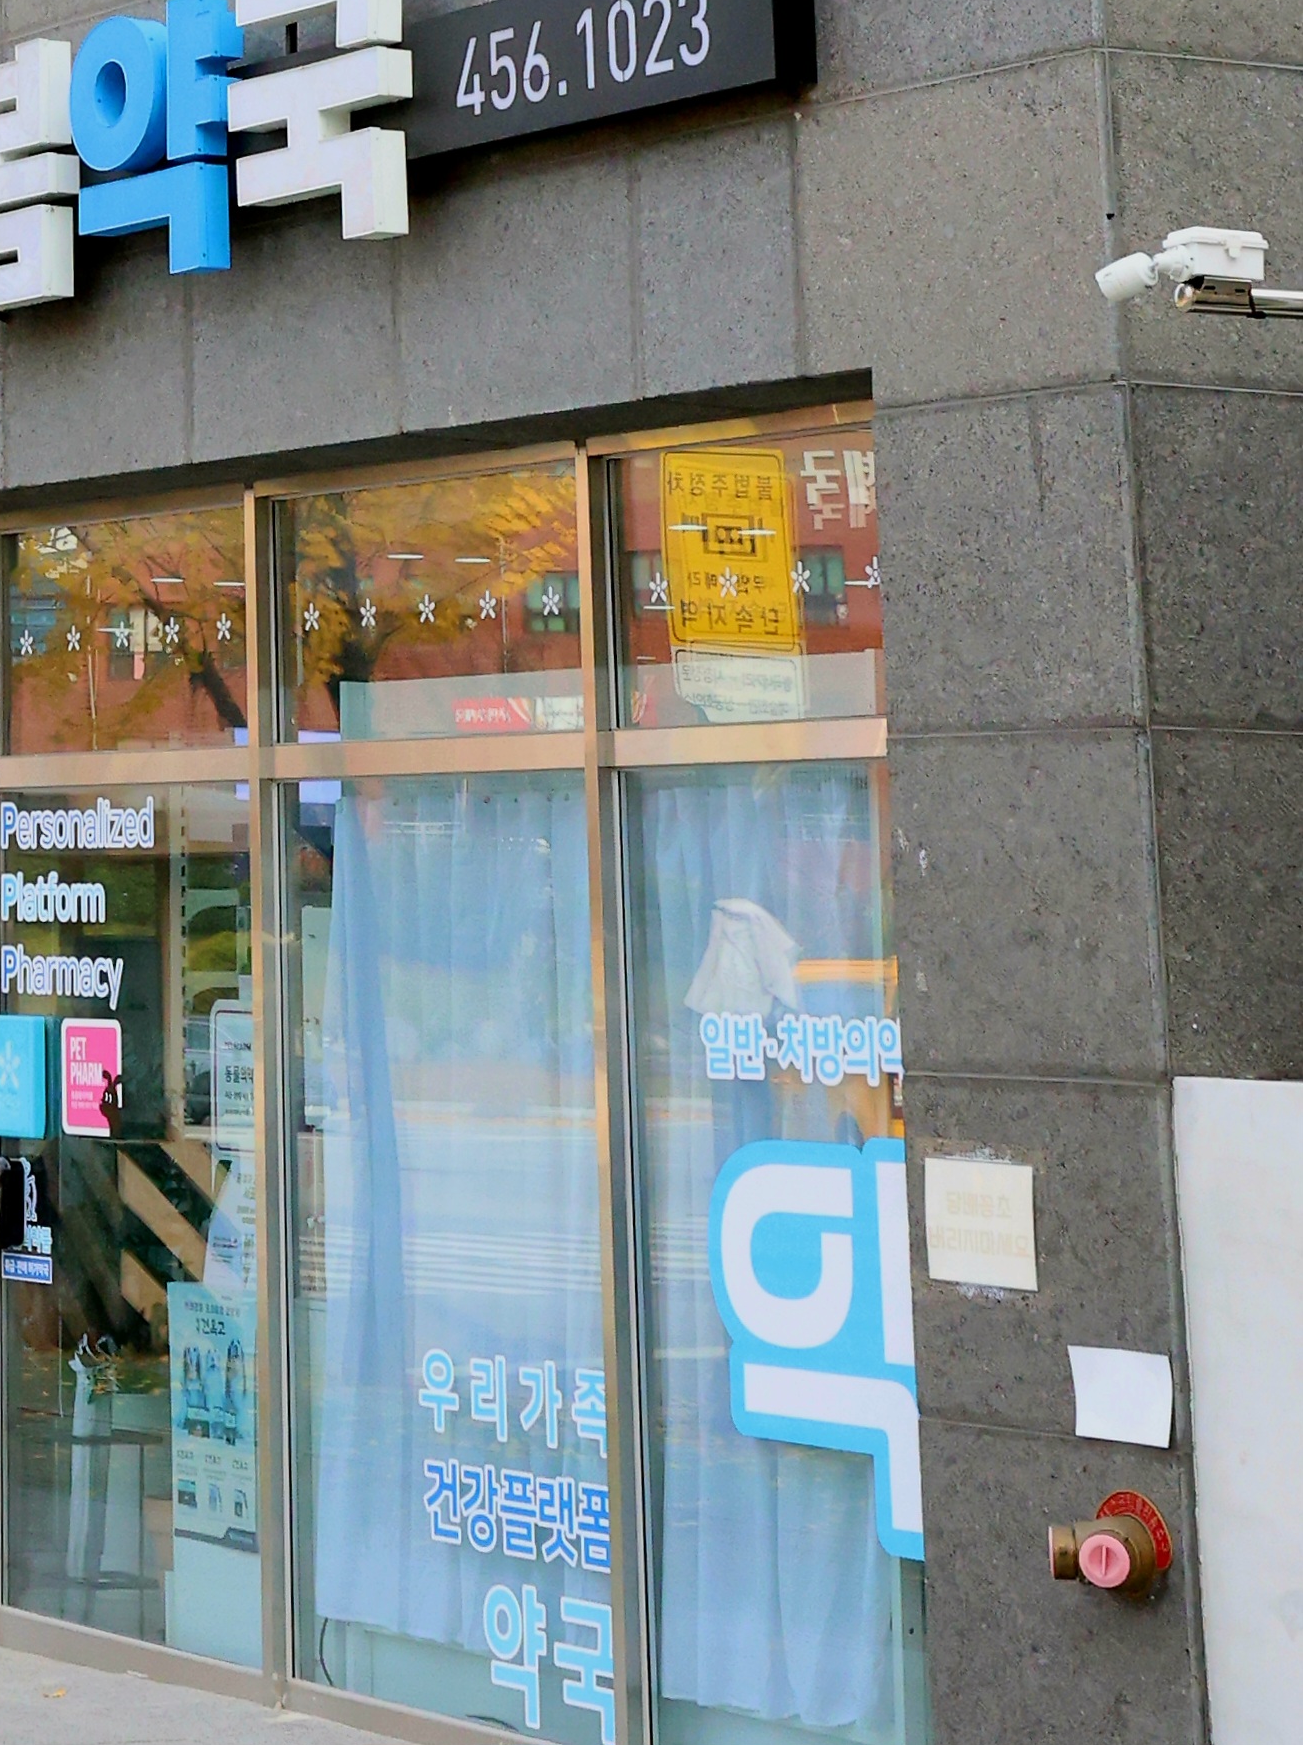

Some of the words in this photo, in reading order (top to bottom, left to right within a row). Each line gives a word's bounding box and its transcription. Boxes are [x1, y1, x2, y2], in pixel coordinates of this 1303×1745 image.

[0, 795, 156, 852] Personalized
[0, 873, 107, 927] Platform
[0, 944, 124, 1011] Pharmacy
[70, 1036, 86, 1060] PET
[70, 1061, 105, 1086] PHARM.
